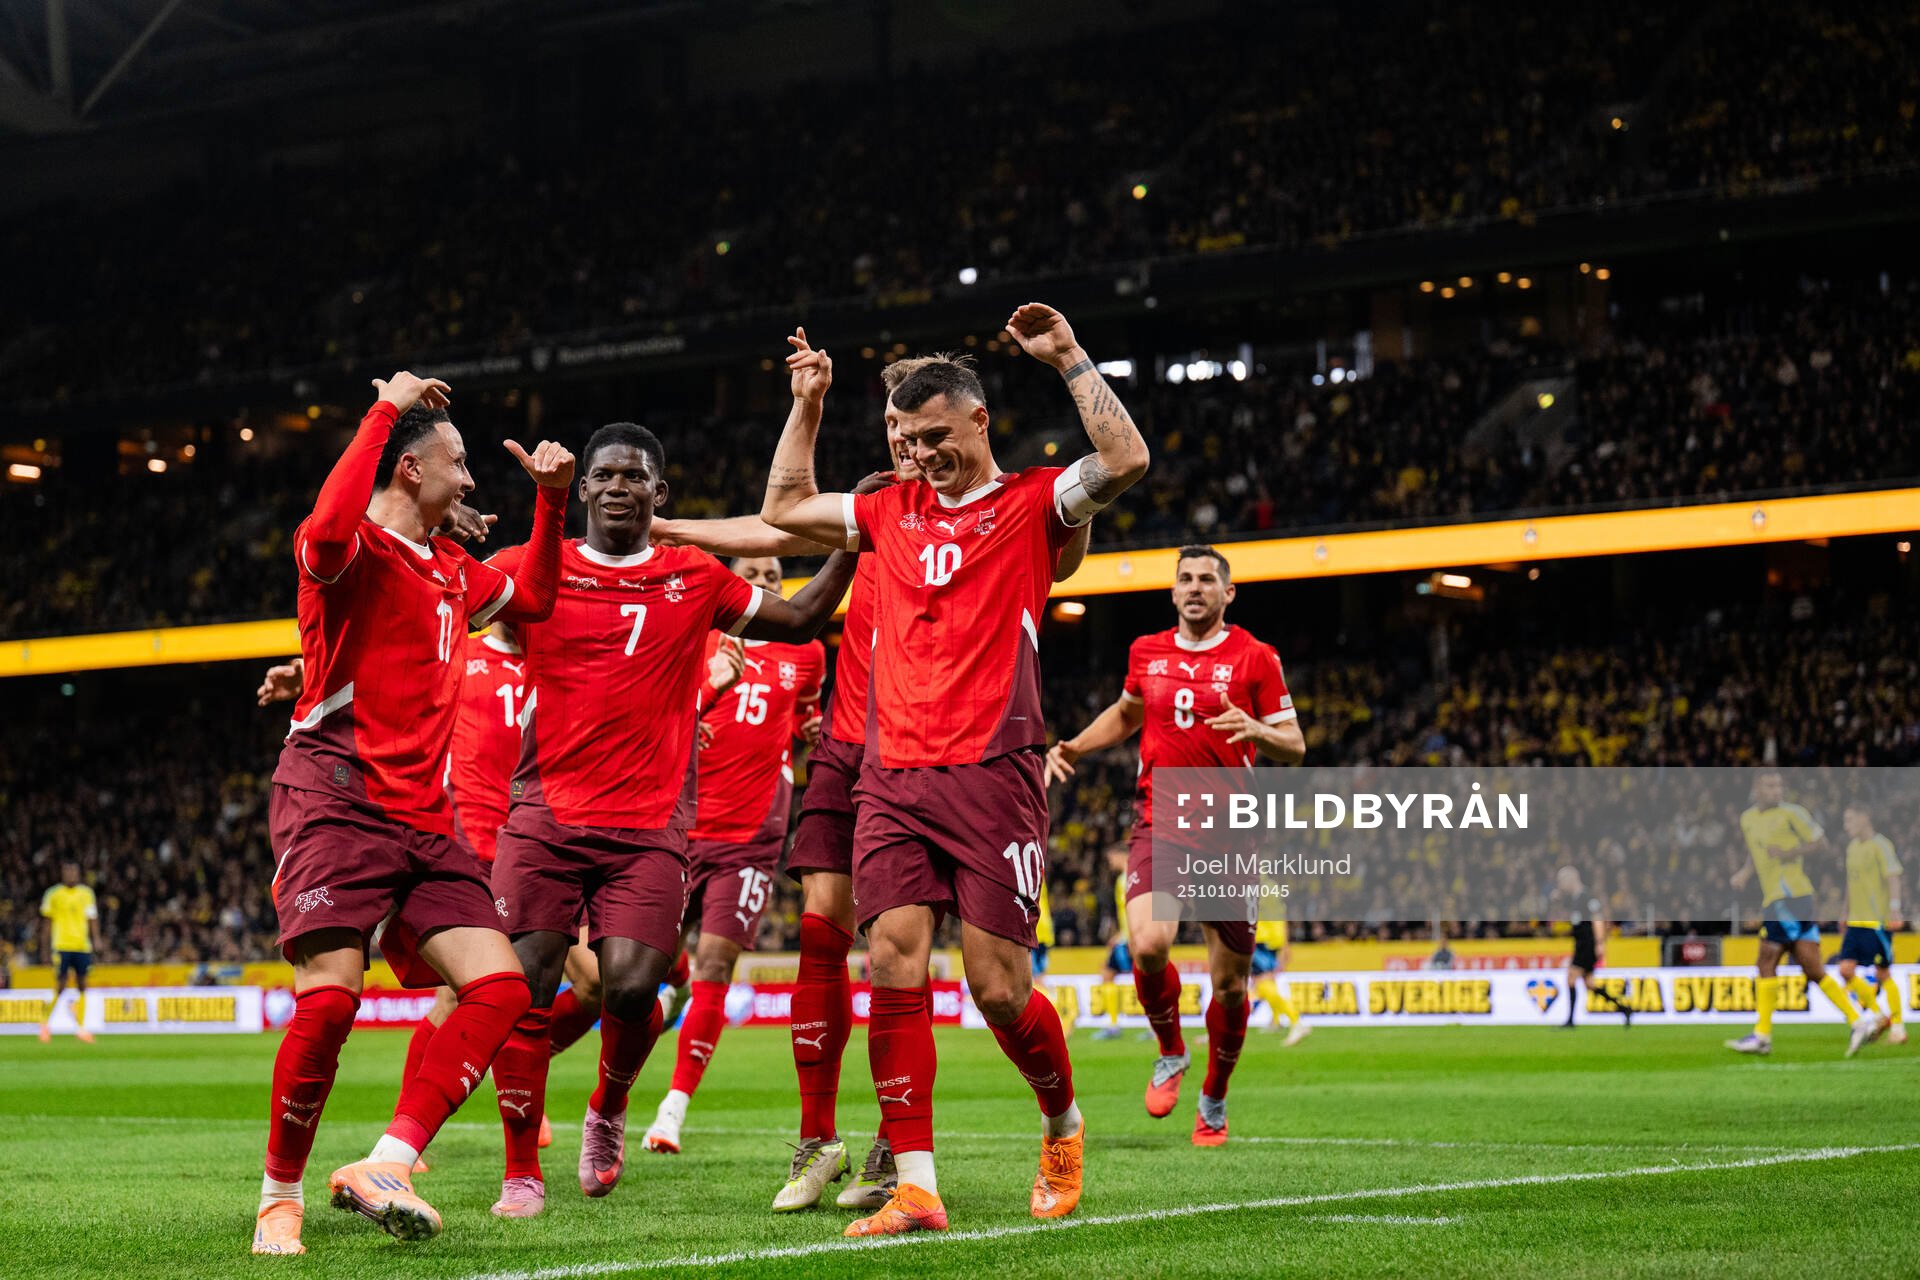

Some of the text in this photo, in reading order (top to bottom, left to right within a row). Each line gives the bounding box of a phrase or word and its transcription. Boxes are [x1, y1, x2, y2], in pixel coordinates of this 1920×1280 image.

[919, 543, 962, 587] 10
[620, 604, 647, 656] 7
[734, 682, 771, 725] 15
[1174, 688, 1195, 729] 8
[738, 866, 769, 913] 15
[1003, 841, 1041, 901] 10
[1289, 980, 1492, 1014] HEJA SVERIGE
[1673, 976, 1809, 1012] SVERGE
[791, 1021, 828, 1031] SUISSE
[874, 1075, 911, 1089] SUISSE
